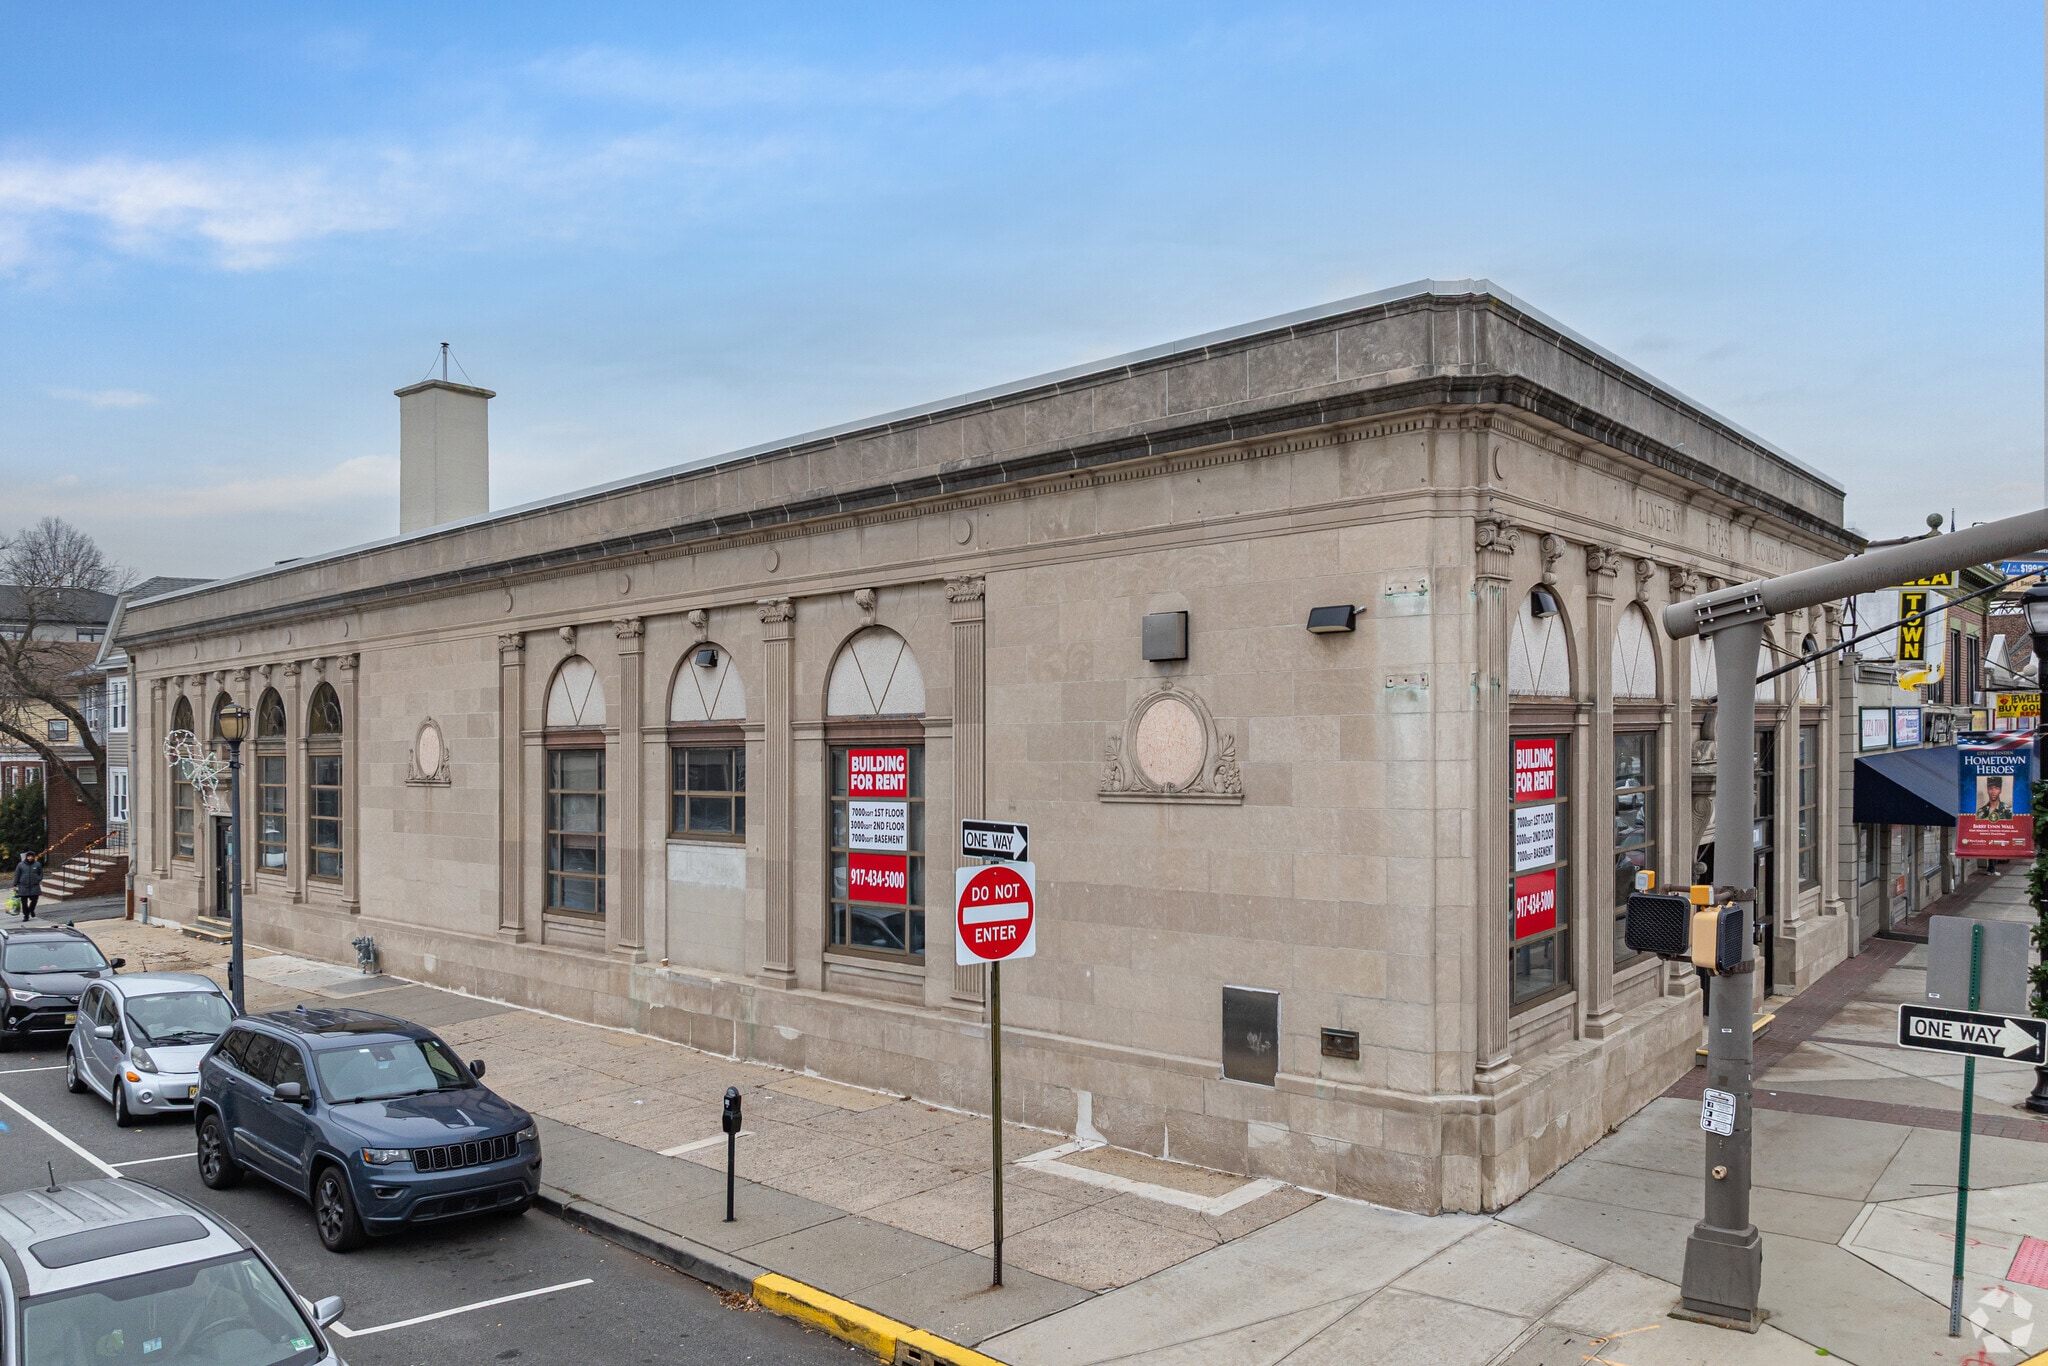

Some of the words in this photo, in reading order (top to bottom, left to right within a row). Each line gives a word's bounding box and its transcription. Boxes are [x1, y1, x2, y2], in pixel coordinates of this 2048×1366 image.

[1638, 499, 1680, 535] LINDEN
[1706, 522, 1733, 552] TRUST
[1755, 541, 1789, 571] COMPANY
[1902, 594, 1923, 659] TOWN
[2011, 694, 2040, 704] JEWELE
[1998, 704, 2019, 712] BUY
[2021, 704, 2040, 712] GOL
[851, 755, 905, 772] BUILDING
[1516, 747, 1554, 770] BUILDING
[1964, 756, 2026, 765] HOMETOWN
[1976, 765, 2015, 775] HEROES
[851, 774, 873, 790] FOR
[875, 773, 906, 790] RENT
[1516, 771, 1533, 793] FOR
[1533, 770, 1554, 791] RENT
[874, 808, 885, 817] 1ST
[885, 808, 905, 818] FLOOR
[1541, 812, 1554, 825] FLOOR
[873, 821, 885, 830] 2ND
[885, 822, 905, 831] FLOOR
[1541, 828, 1554, 841] FLOOR
[874, 834, 904, 845] BASEMENT
[965, 831, 988, 848] ONE
[991, 833, 1014, 850] WAY
[1533, 845, 1554, 859] BASEMENT
[850, 868, 905, 889] 917-434-5000
[971, 886, 990, 902] DO
[995, 883, 1020, 900] NOT
[1516, 888, 1555, 919] 917-434-5000
[975, 924, 1017, 944] ENTER
[1914, 1019, 1953, 1039] ONE
[1960, 1024, 2001, 1045] WAY
